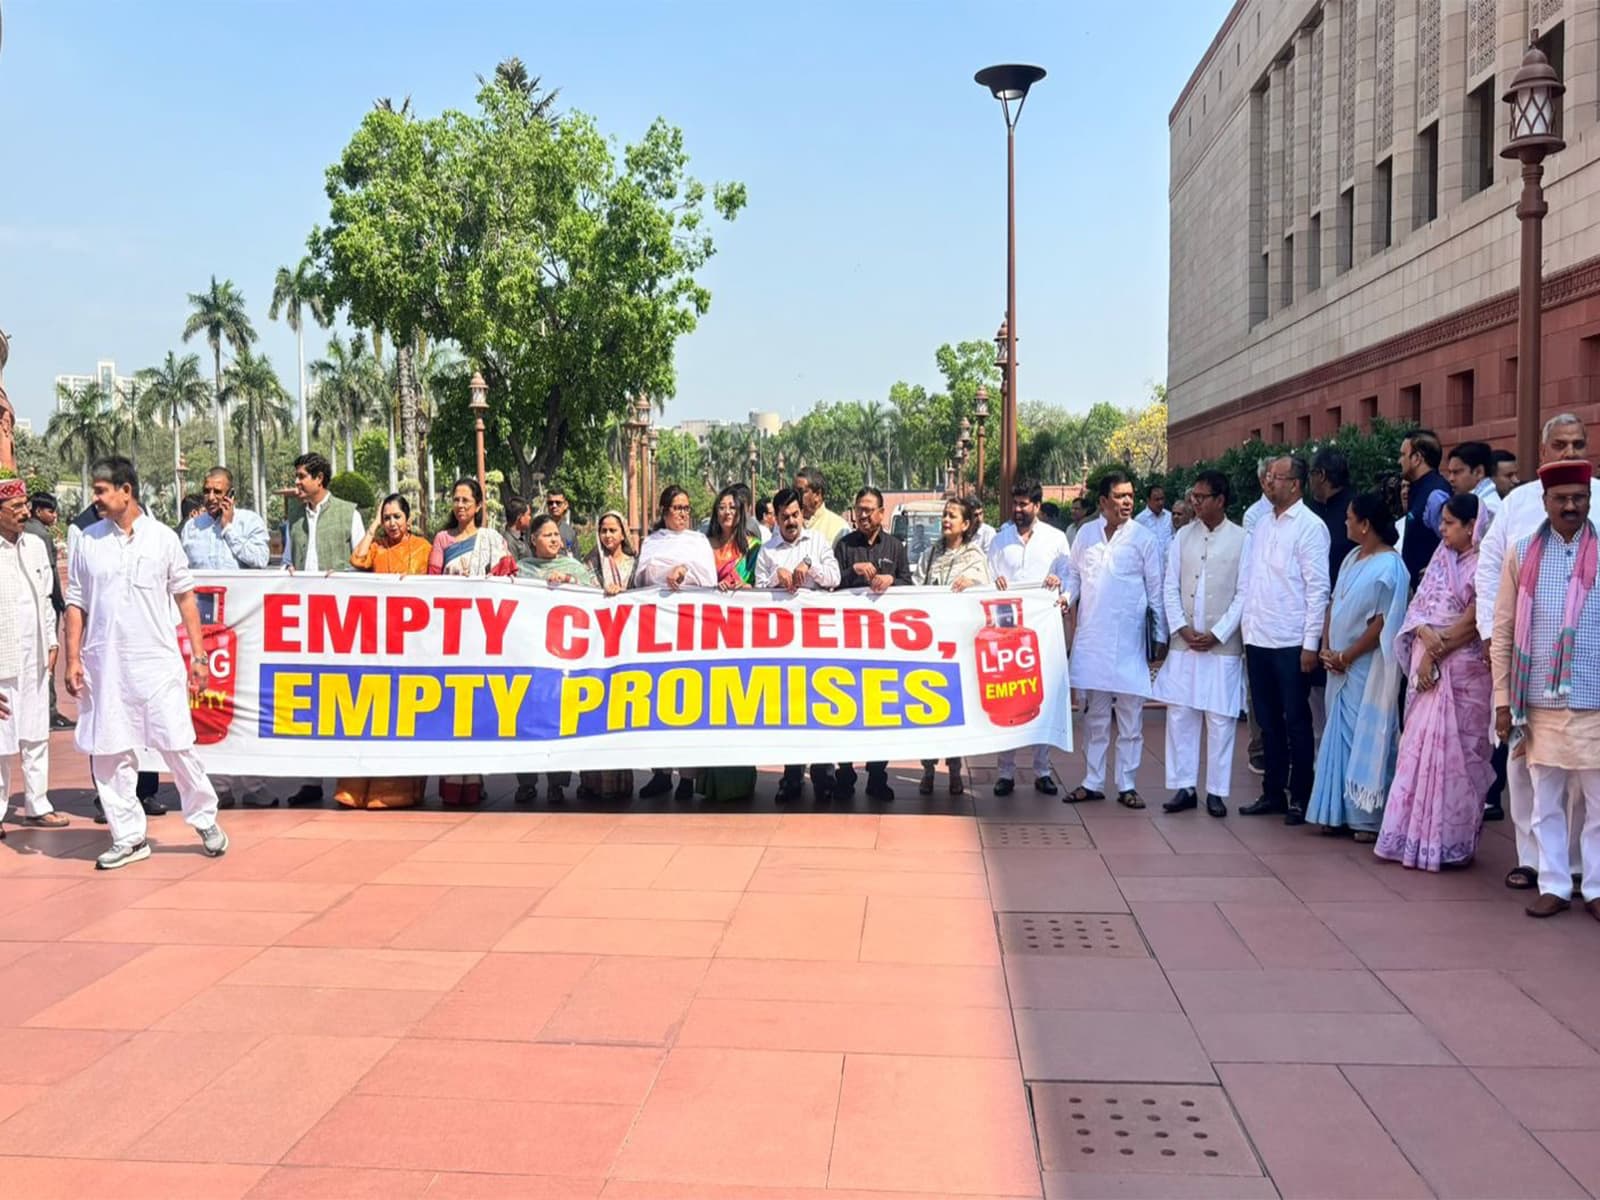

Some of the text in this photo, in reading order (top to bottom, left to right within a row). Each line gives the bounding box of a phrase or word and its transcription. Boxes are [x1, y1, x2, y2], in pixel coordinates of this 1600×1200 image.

[263, 593, 957, 660] EMPTY CYLINDERS,
[980, 646, 1036, 673] LPG
[272, 665, 951, 737] EMPTY PROMISES
[985, 676, 1038, 700] EMPTY
